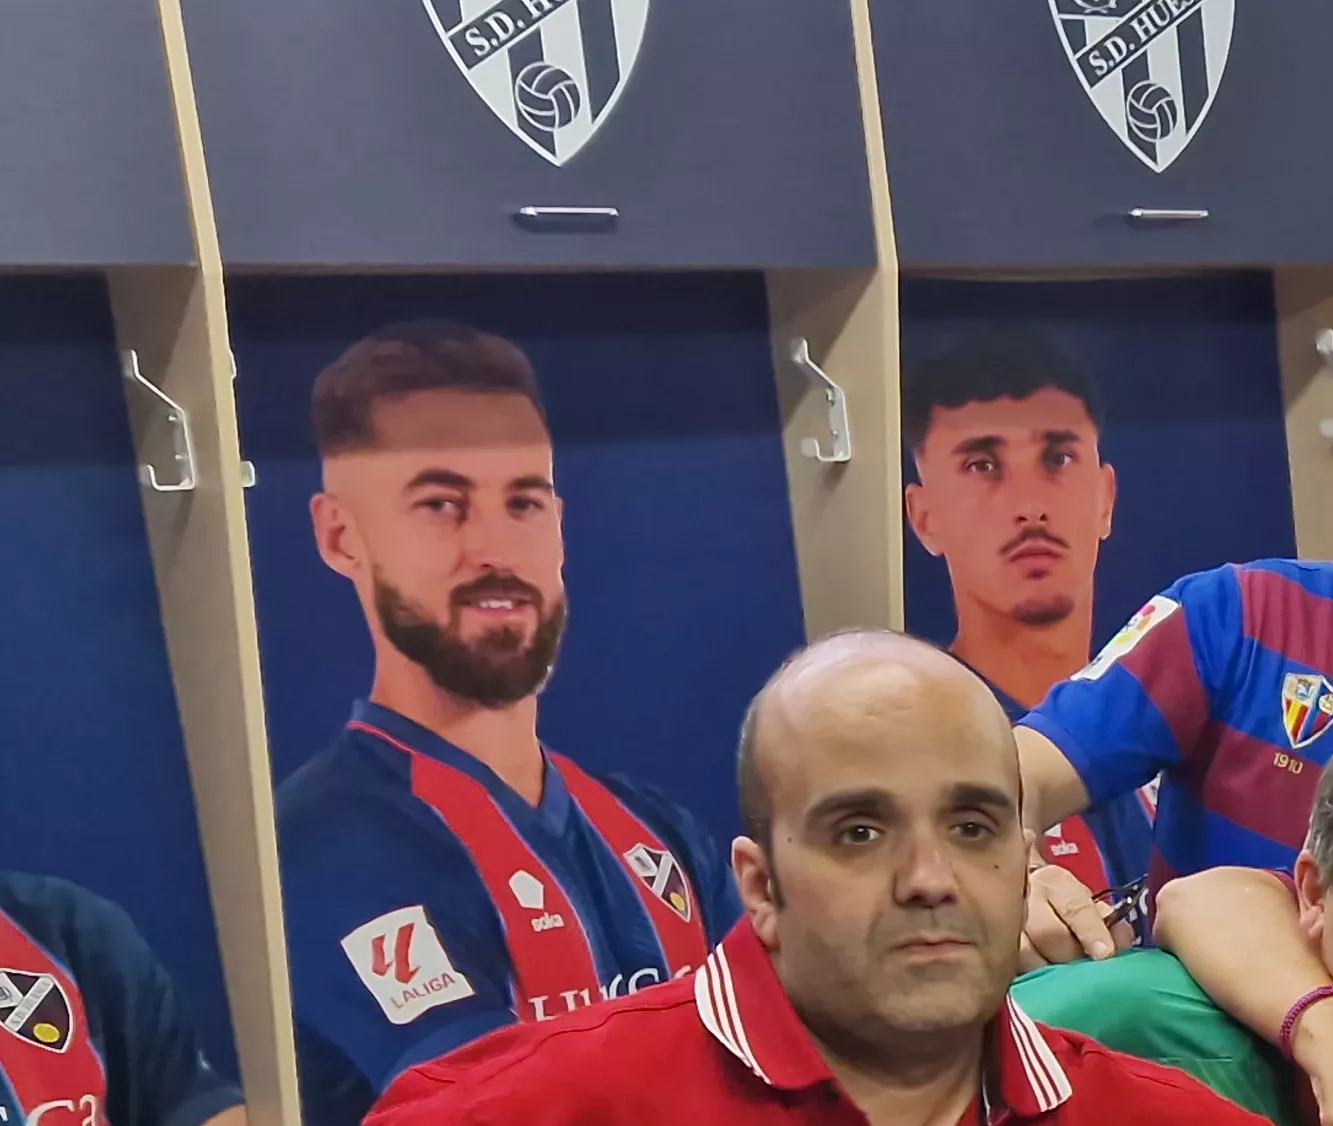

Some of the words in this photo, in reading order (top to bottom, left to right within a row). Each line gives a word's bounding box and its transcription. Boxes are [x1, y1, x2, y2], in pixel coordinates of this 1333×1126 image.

[465, 11, 525, 57] S.D.
[1088, 36, 1135, 76] S.D.
[1273, 752, 1304, 774] 1910
[390, 972, 456, 1009] LALIGA
